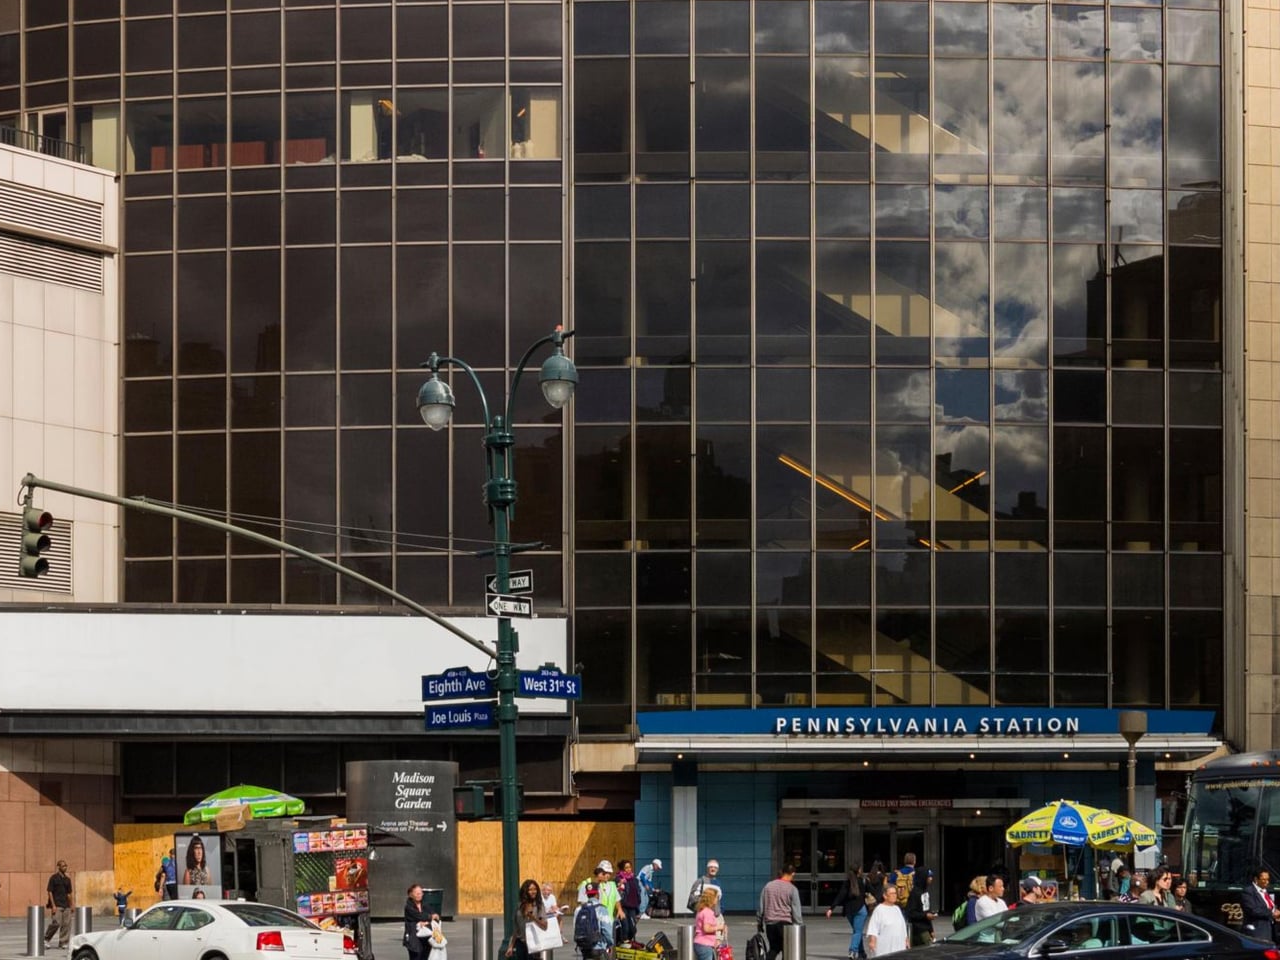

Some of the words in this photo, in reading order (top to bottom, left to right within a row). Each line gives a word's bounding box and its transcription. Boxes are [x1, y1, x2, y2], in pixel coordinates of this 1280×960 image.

[493, 601, 508, 611] ONE
[513, 603, 527, 613] WAY
[429, 680, 462, 696] Eighth
[465, 678, 486, 691] Ave
[524, 677, 547, 692] West
[549, 679, 565, 692] 31st
[566, 681, 576, 694] St
[432, 711, 446, 724] Joe
[448, 709, 472, 723] Louis
[776, 717, 967, 733] PENNSYLVANIA
[979, 717, 1080, 733] STATION
[392, 771, 435, 784] Madison
[395, 784, 432, 798] Square
[394, 798, 432, 809] Garden
[1009, 830, 1050, 840] SABRETT
[1092, 824, 1126, 842] SABRETT
